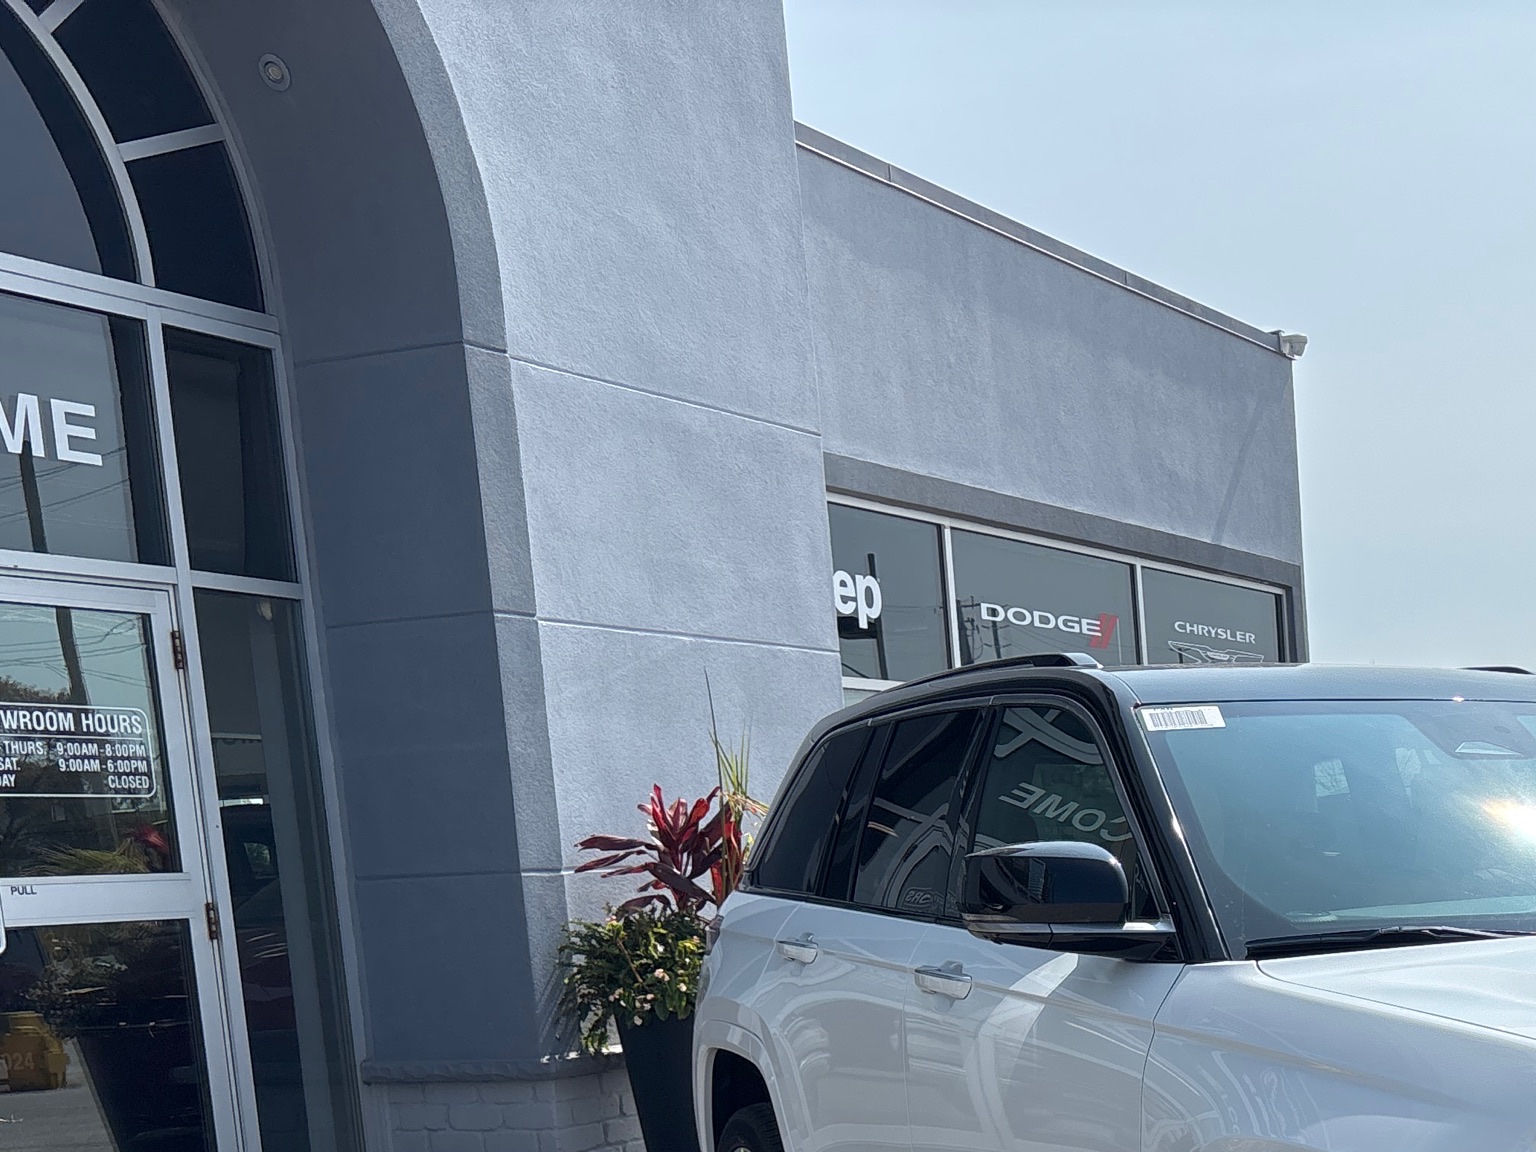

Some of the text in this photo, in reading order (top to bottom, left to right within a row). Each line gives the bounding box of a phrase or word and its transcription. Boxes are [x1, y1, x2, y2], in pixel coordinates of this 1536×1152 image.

[0, 392, 103, 466] ME
[833, 570, 882, 629] ep
[980, 602, 1103, 637] DODGE
[1174, 621, 1256, 644] CHRYSLER
[0, 710, 143, 734] WROOM HOURS
[0, 774, 149, 789] AY CLOSED
[10, 886, 38, 896] PULL
